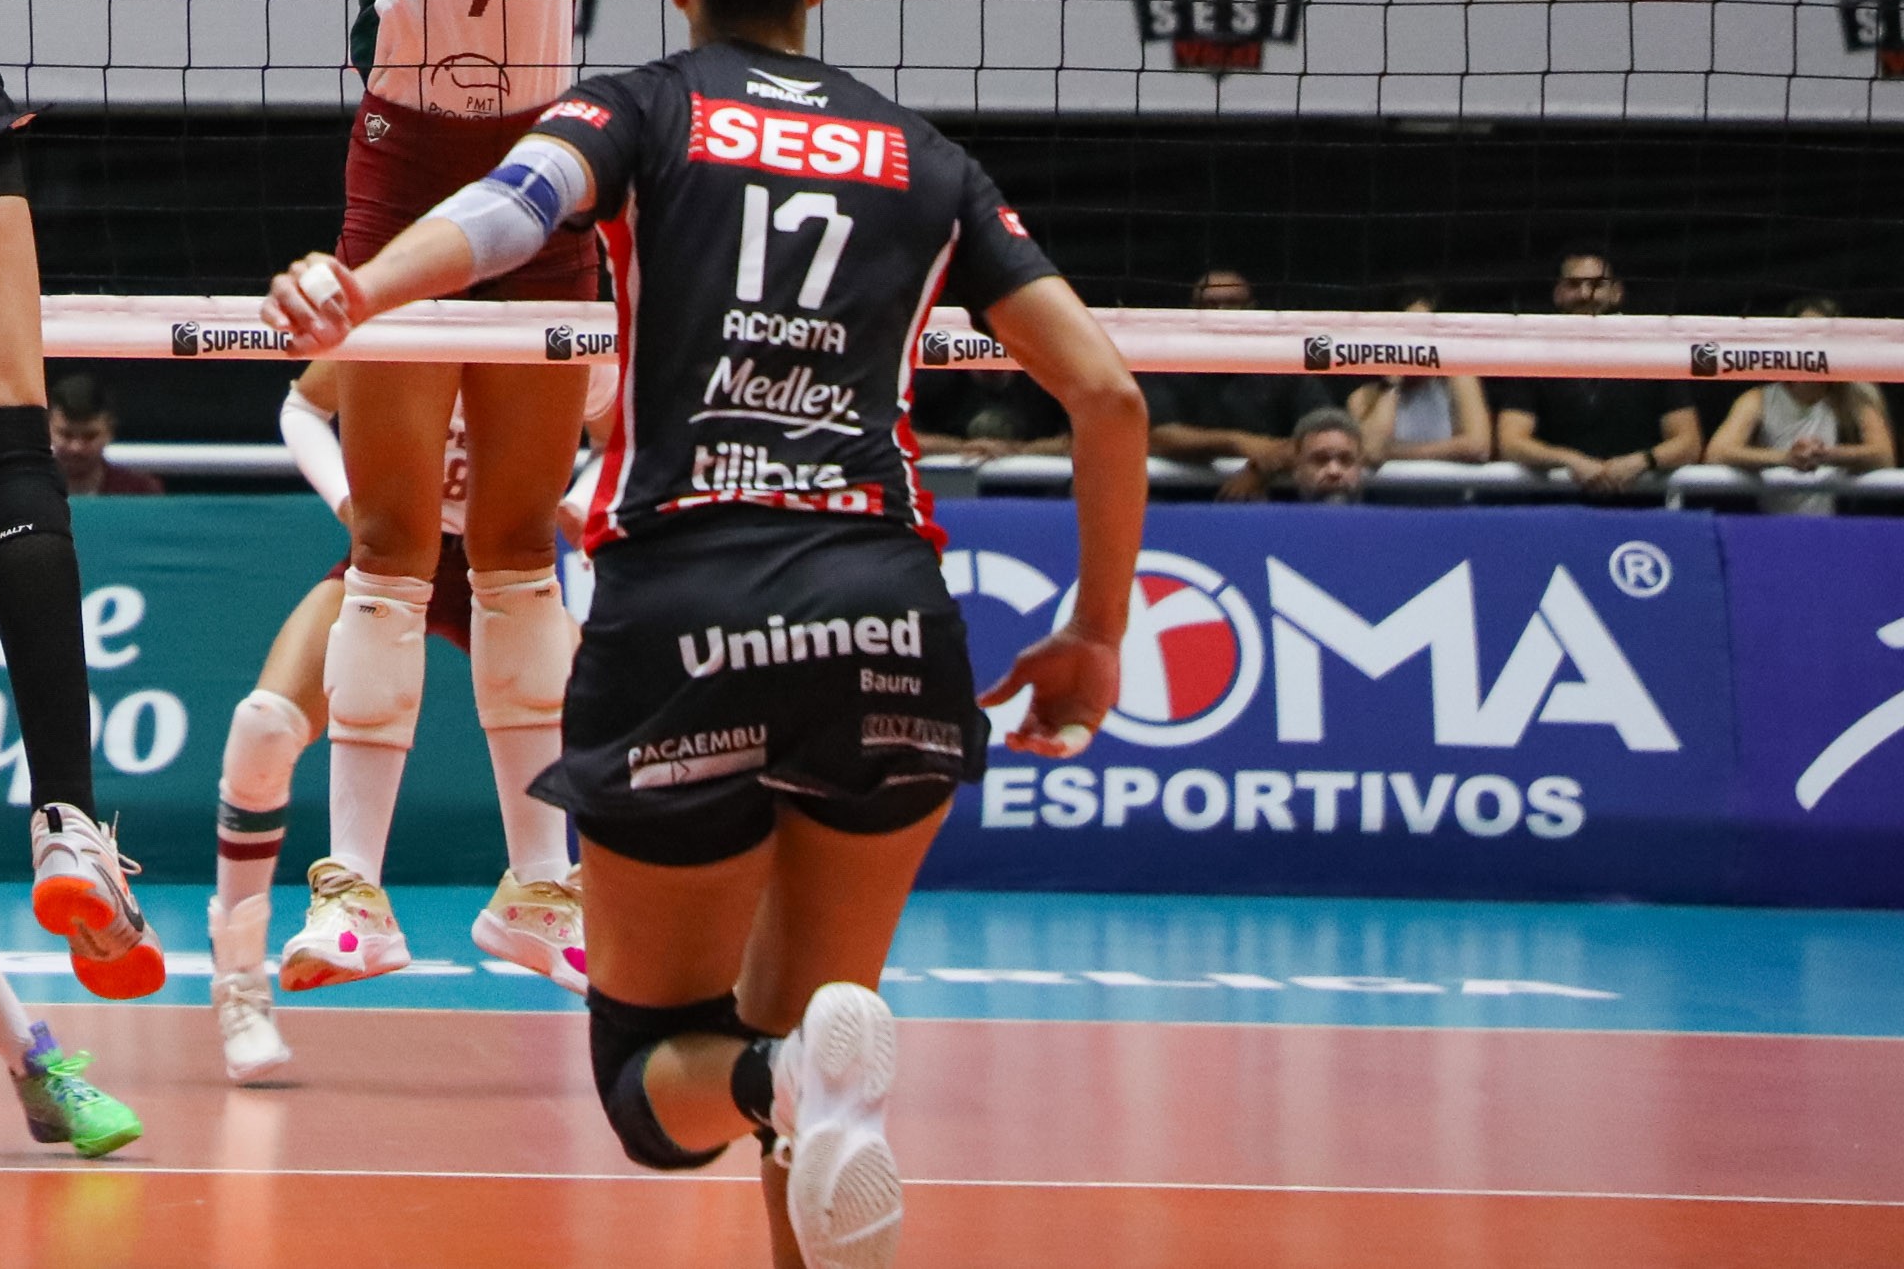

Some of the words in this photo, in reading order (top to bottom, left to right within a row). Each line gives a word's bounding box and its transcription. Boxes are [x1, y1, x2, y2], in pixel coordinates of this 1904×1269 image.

[466, 96, 495, 111] PMT
[747, 81, 829, 109] PENALTY
[706, 106, 883, 179] SESI
[736, 183, 854, 310] 17
[202, 330, 291, 353] SUPERLIG
[724, 309, 846, 354] ACOSTA
[1335, 343, 1440, 369] SUPERLIGA
[1722, 349, 1829, 374] SUPERLIGA
[678, 610, 922, 678] Unimed
[860, 668, 922, 696] Bauru
[628, 725, 768, 769] PACAEMBU
[980, 766, 1586, 839] ESPORTIVOS
